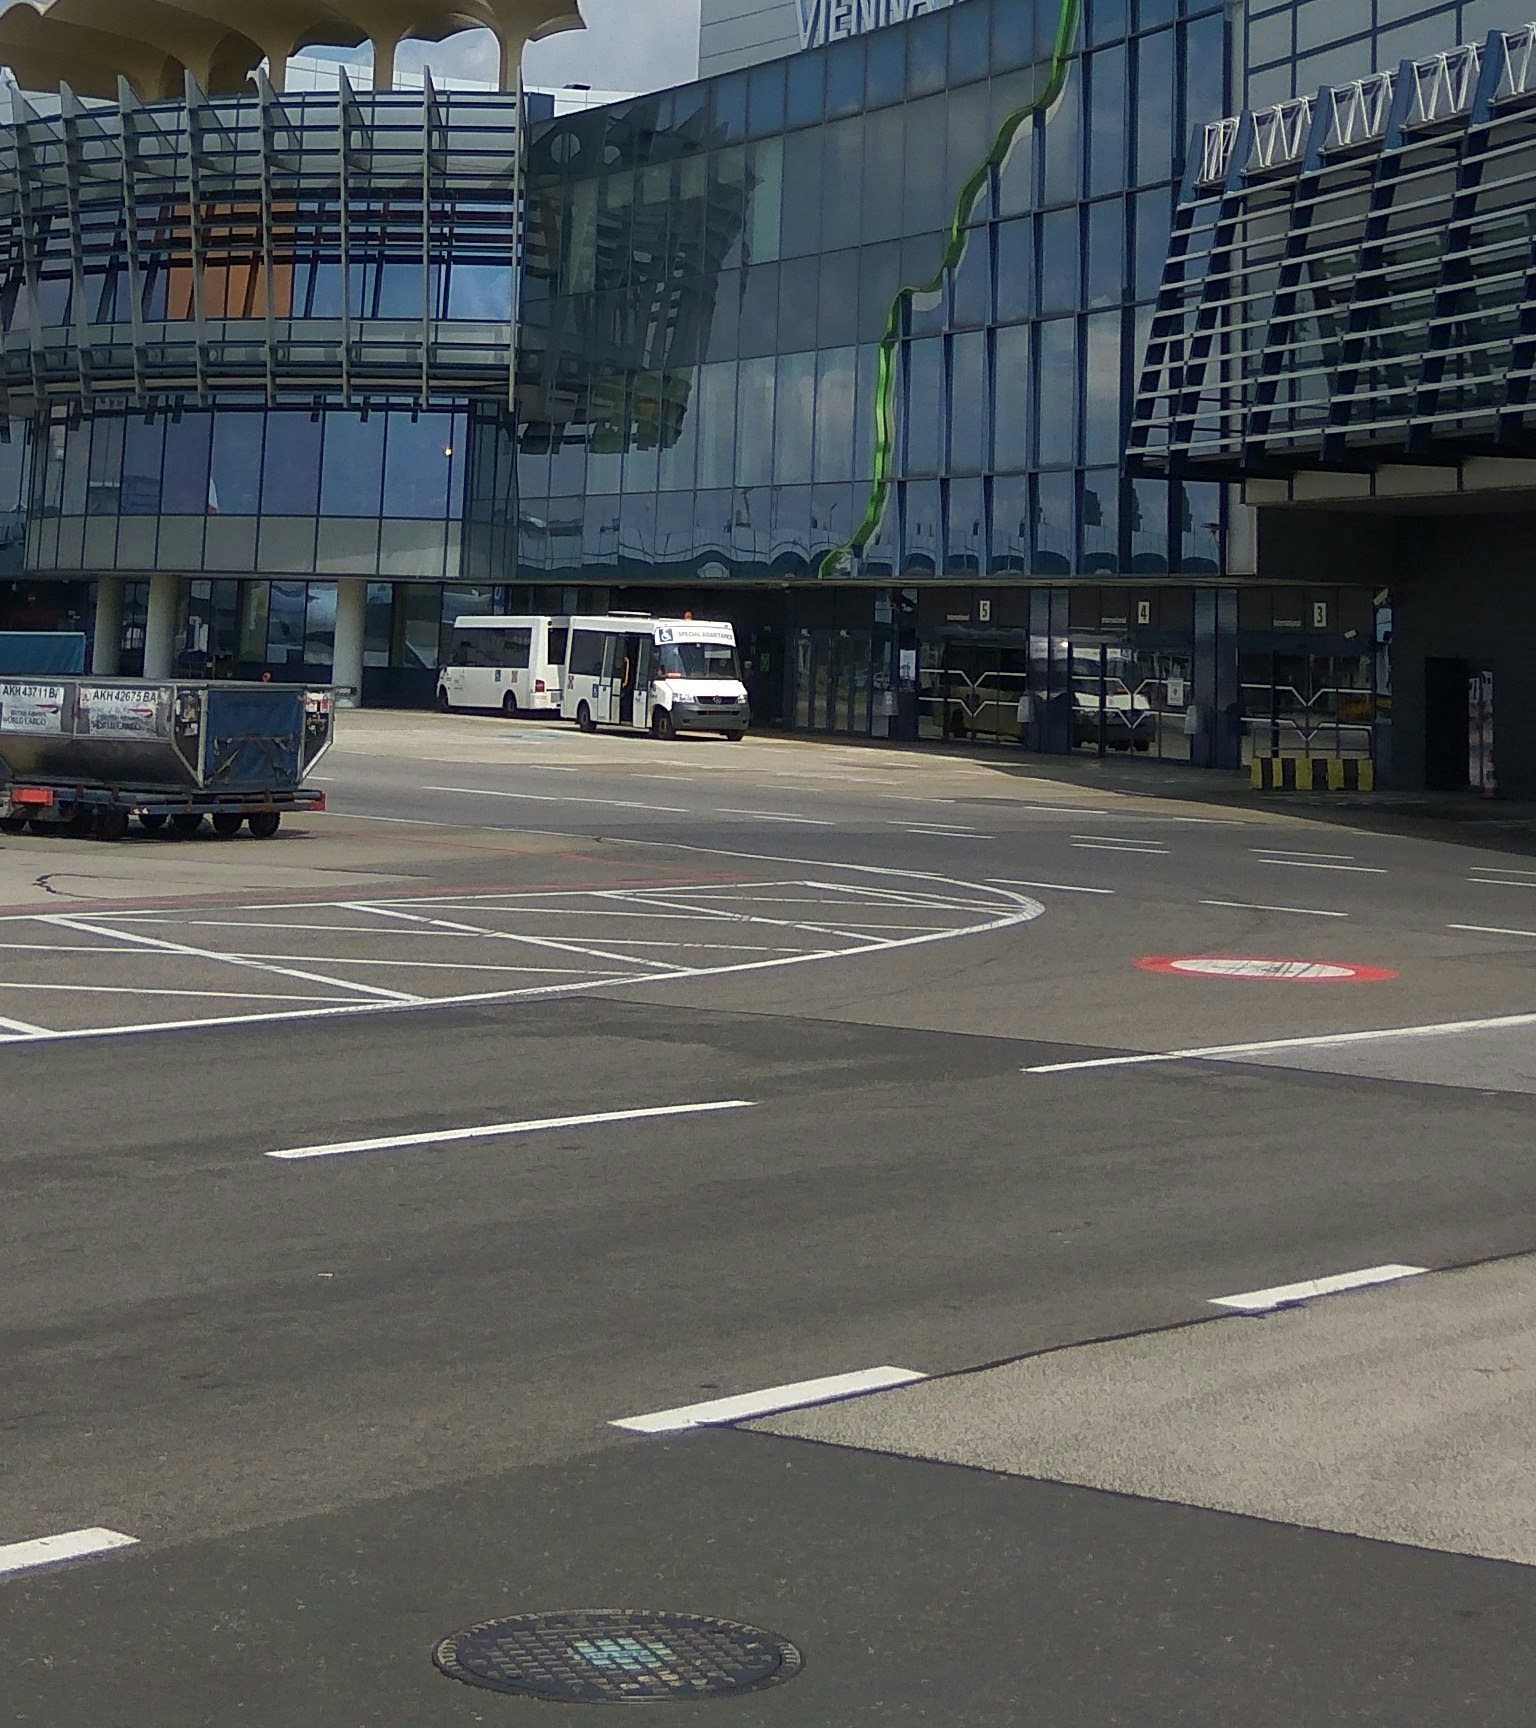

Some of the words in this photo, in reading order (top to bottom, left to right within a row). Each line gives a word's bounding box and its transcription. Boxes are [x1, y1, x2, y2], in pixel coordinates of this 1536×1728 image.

[3, 685, 21, 697] AKH
[21, 685, 47, 698] 43711
[92, 690, 113, 702] AKH
[114, 690, 141, 702] 42675
[143, 691, 156, 703] BA
